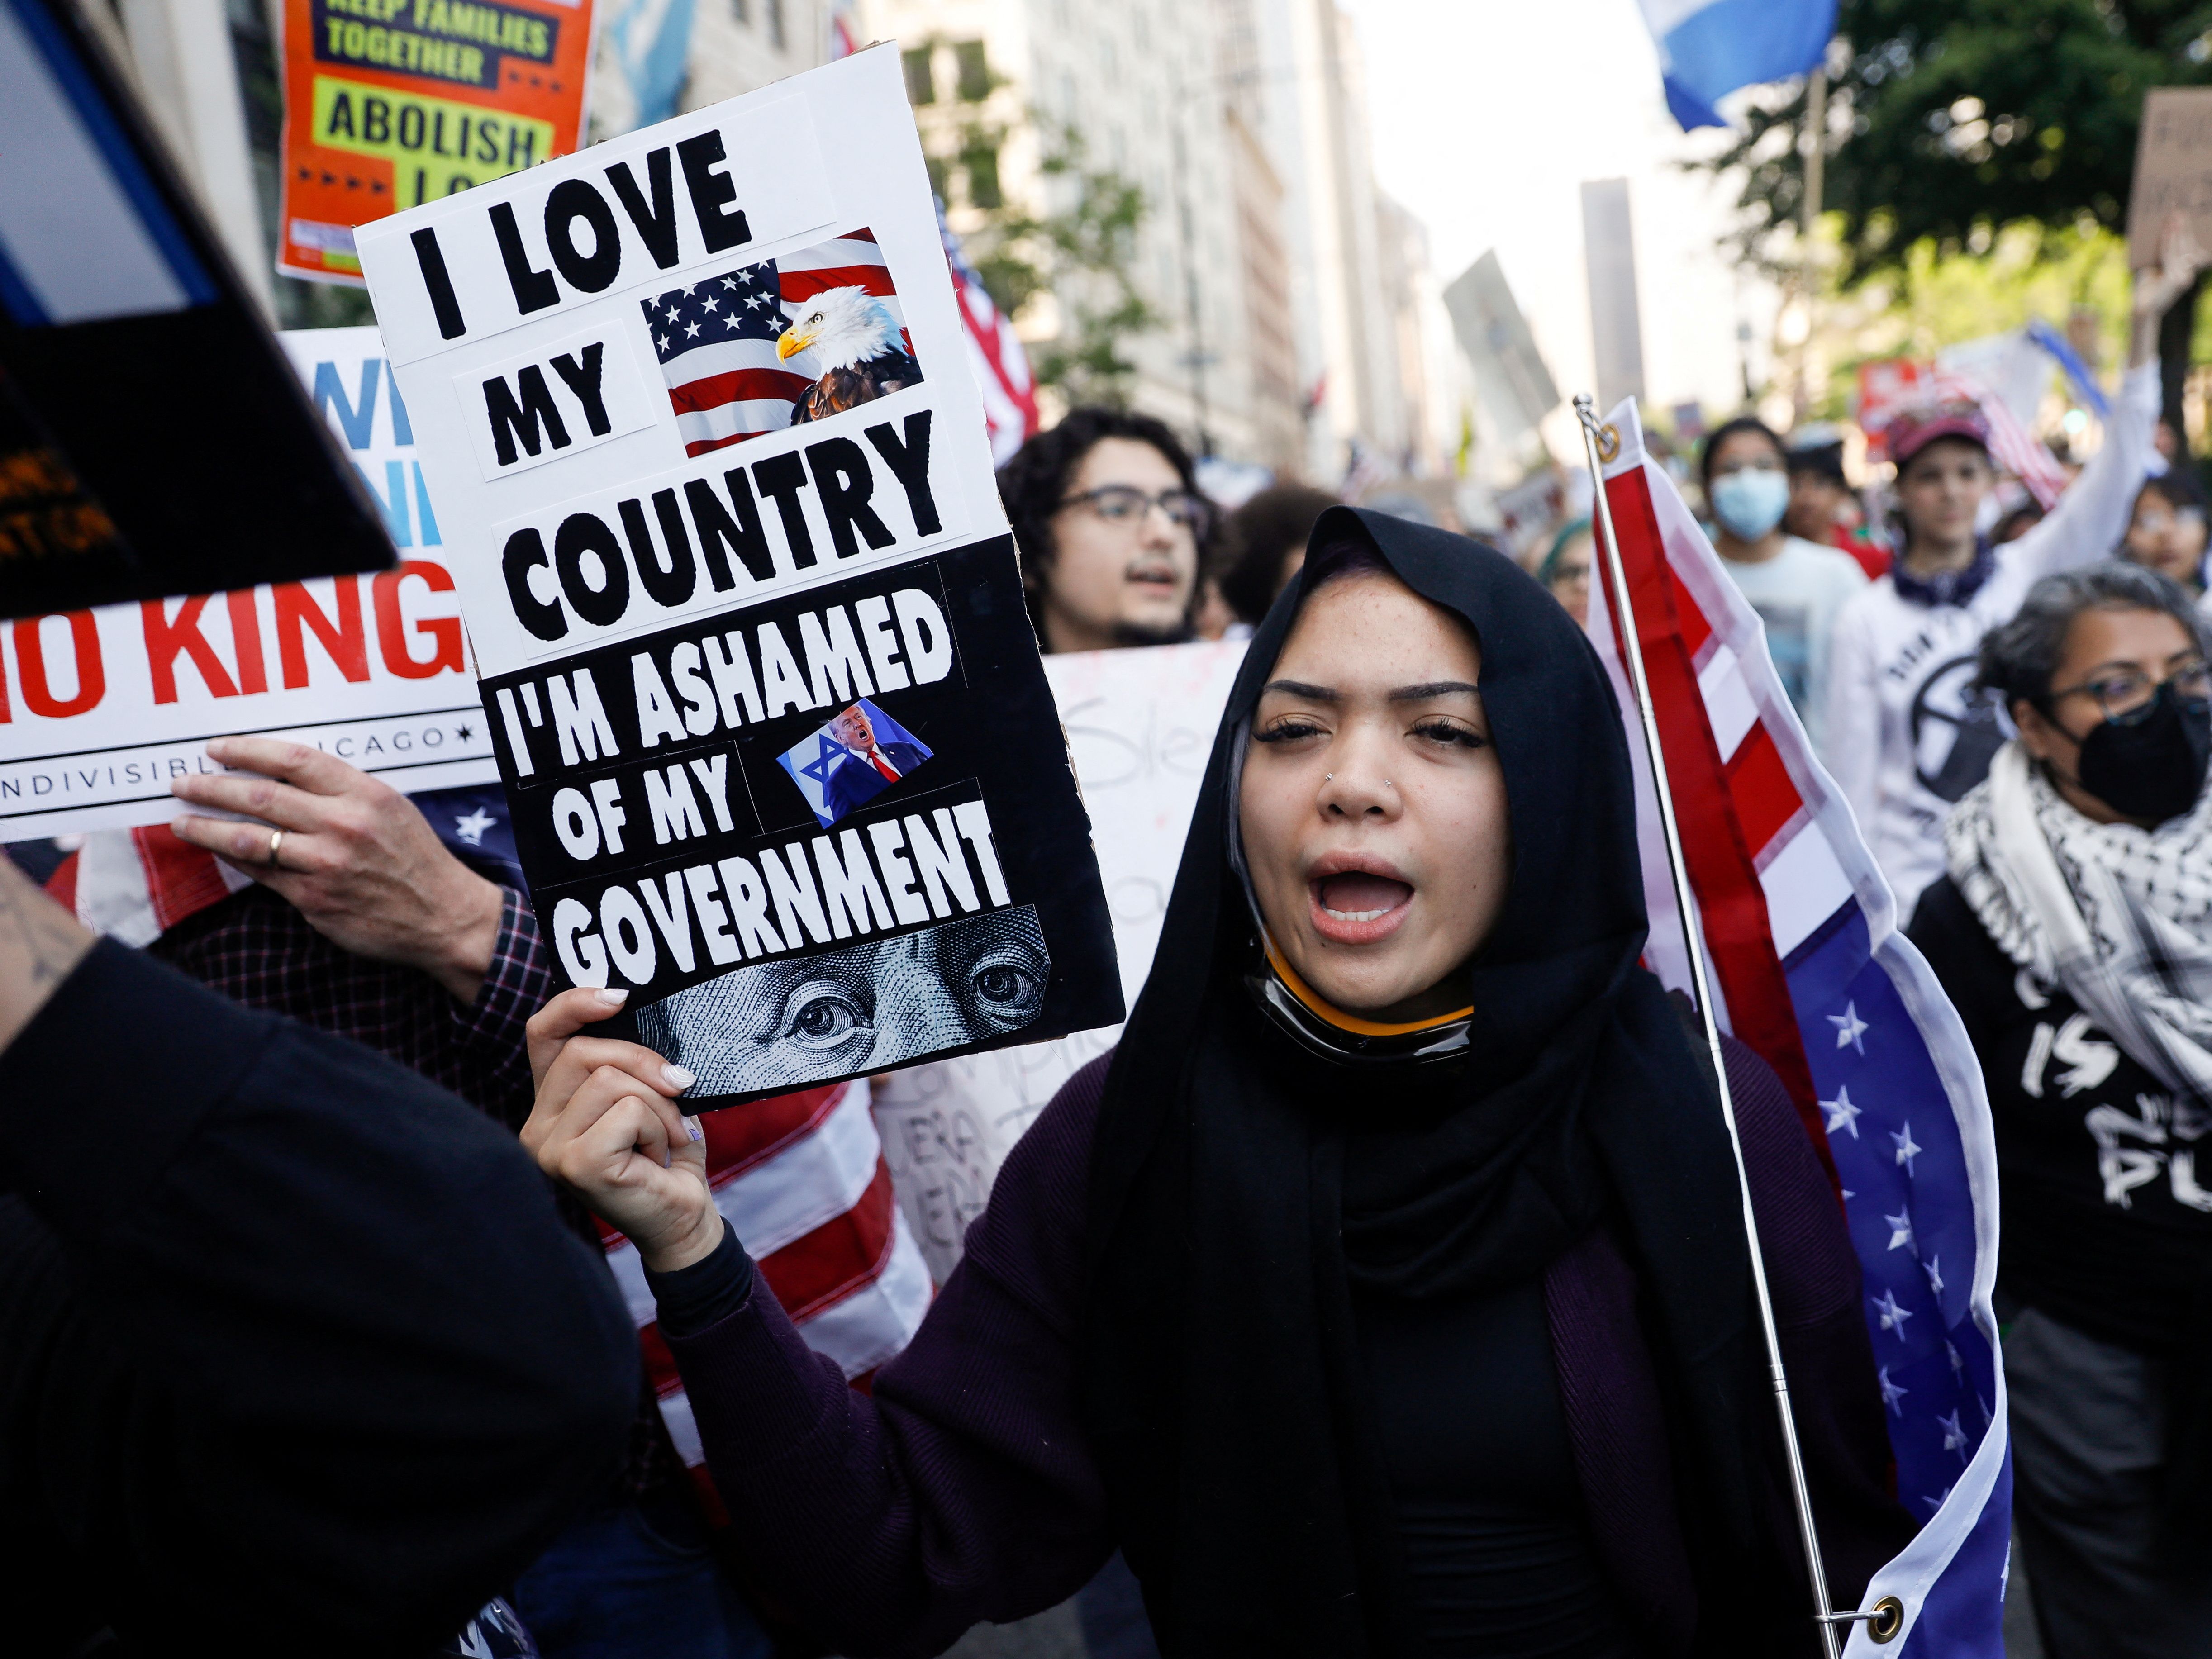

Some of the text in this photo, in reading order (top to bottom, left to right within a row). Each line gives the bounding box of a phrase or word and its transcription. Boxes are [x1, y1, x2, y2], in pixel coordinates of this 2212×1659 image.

[324, 0, 550, 57] EP FAMILIES
[325, 16, 485, 85] TOGETHER
[329, 92, 535, 168] ABOLISH
[410, 129, 752, 340] I LOVE
[482, 342, 611, 466] MY
[502, 409, 942, 642] COUNTRY
[0, 559, 465, 723] O KING
[496, 589, 953, 777] I'M ASHAMED
[1, 727, 446, 799] NDIVISIBL ICAGO
[552, 754, 728, 860] OF MY
[552, 800, 1012, 989] GOVERNMENT
